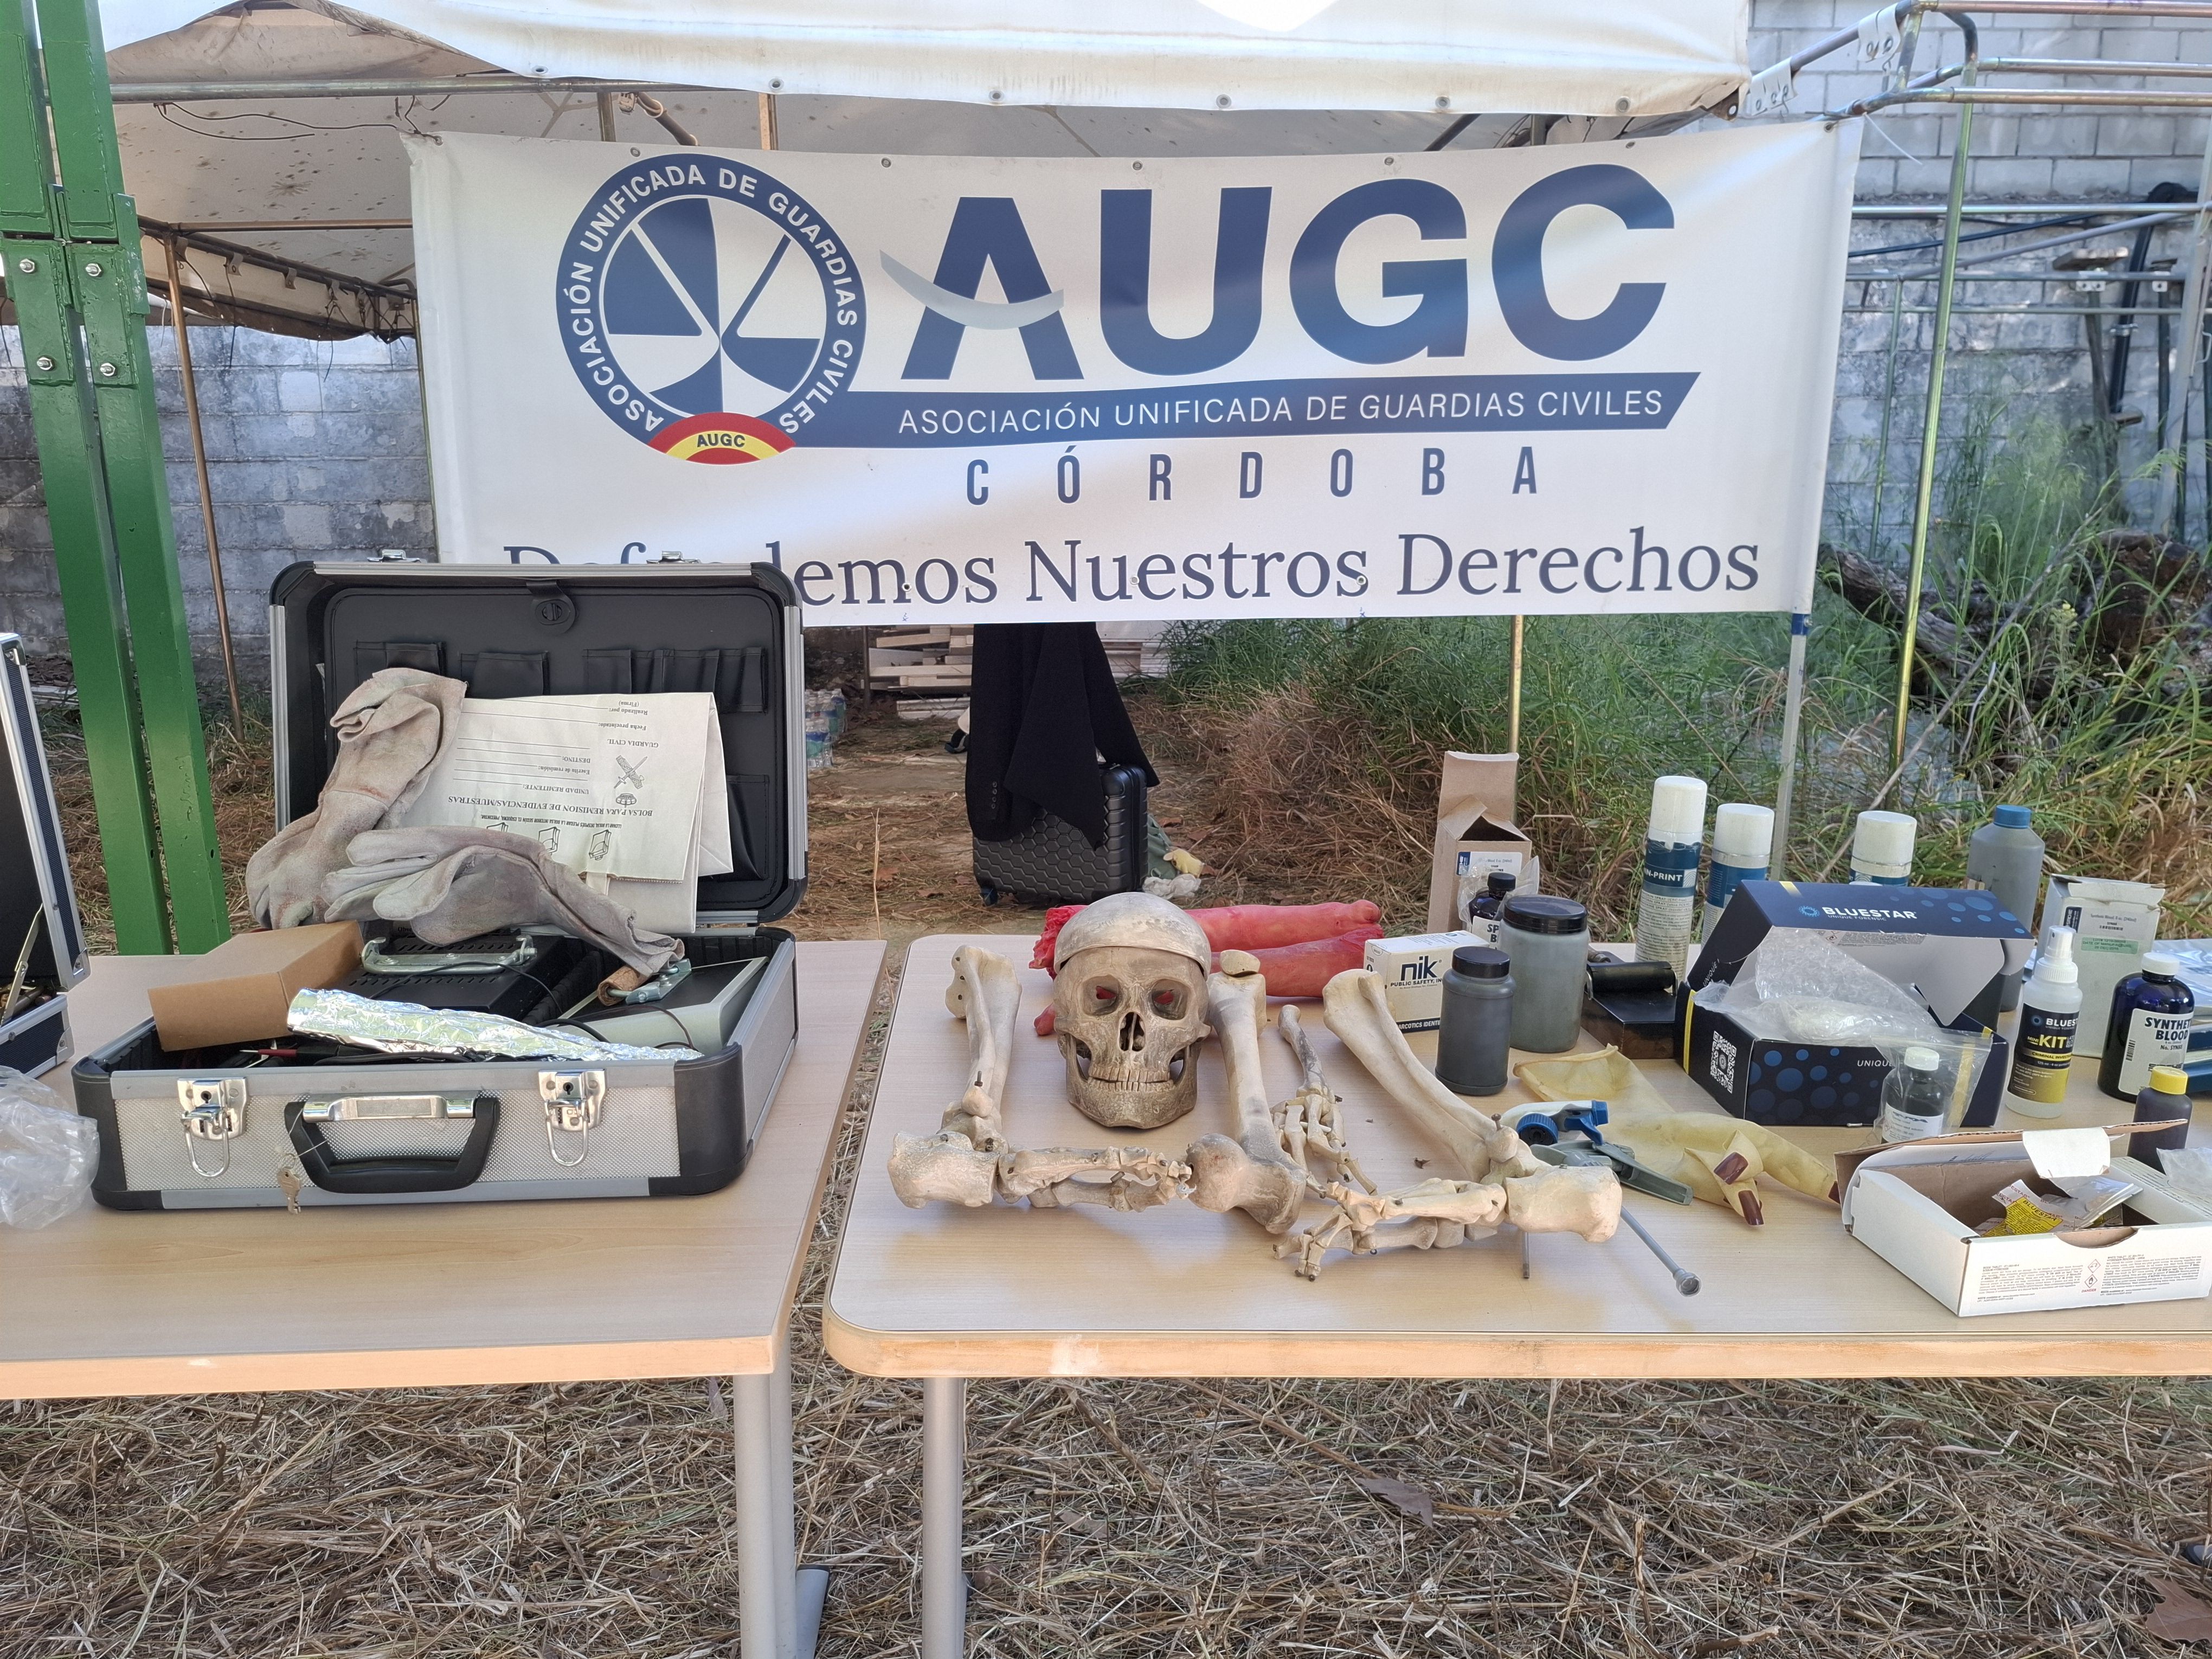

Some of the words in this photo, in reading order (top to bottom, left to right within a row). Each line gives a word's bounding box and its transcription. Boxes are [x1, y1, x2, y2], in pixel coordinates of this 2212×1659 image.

[718, 167, 758, 198] DE
[580, 164, 706, 252] UNIFICADA
[768, 191, 858, 326] GUARDIAS
[899, 164, 1675, 381] AUGC
[563, 262, 664, 432] ASOCIACIÓN
[778, 339, 853, 434] CIVILES
[898, 402, 1100, 434] ASOCIACIÓN
[1114, 397, 1293, 426] UNIFICADA
[1306, 396, 1347, 421] DE
[1359, 391, 1525, 419] GUARDIAS
[1538, 390, 1663, 416] CIVILES
[696, 433, 745, 448] AUGC
[966, 445, 1538, 506] CÓRDOBA
[1024, 539, 1369, 603] Nuestros
[1396, 526, 1759, 597] Derechos
[627, 740, 659, 748] GUARDIA
[522, 784, 564, 793] REMITENTE:
[448, 796, 548, 810] EVIDENCIAS/MUESTRAS
[563, 805, 605, 815] REMISION
[1822, 906, 1918, 919] BLUESTAR
[1400, 955, 1438, 981] nik
[1702, 961, 1718, 987] UNIQUE
[1398, 1021, 1423, 1030] ARCOTICS
[2144, 1017, 2191, 1030] SYNTHET
[2155, 1030, 2188, 1041] BLOOD
[2039, 1034, 2067, 1049] KIT
[2022, 1200, 2058, 1222] BLUESTAR
